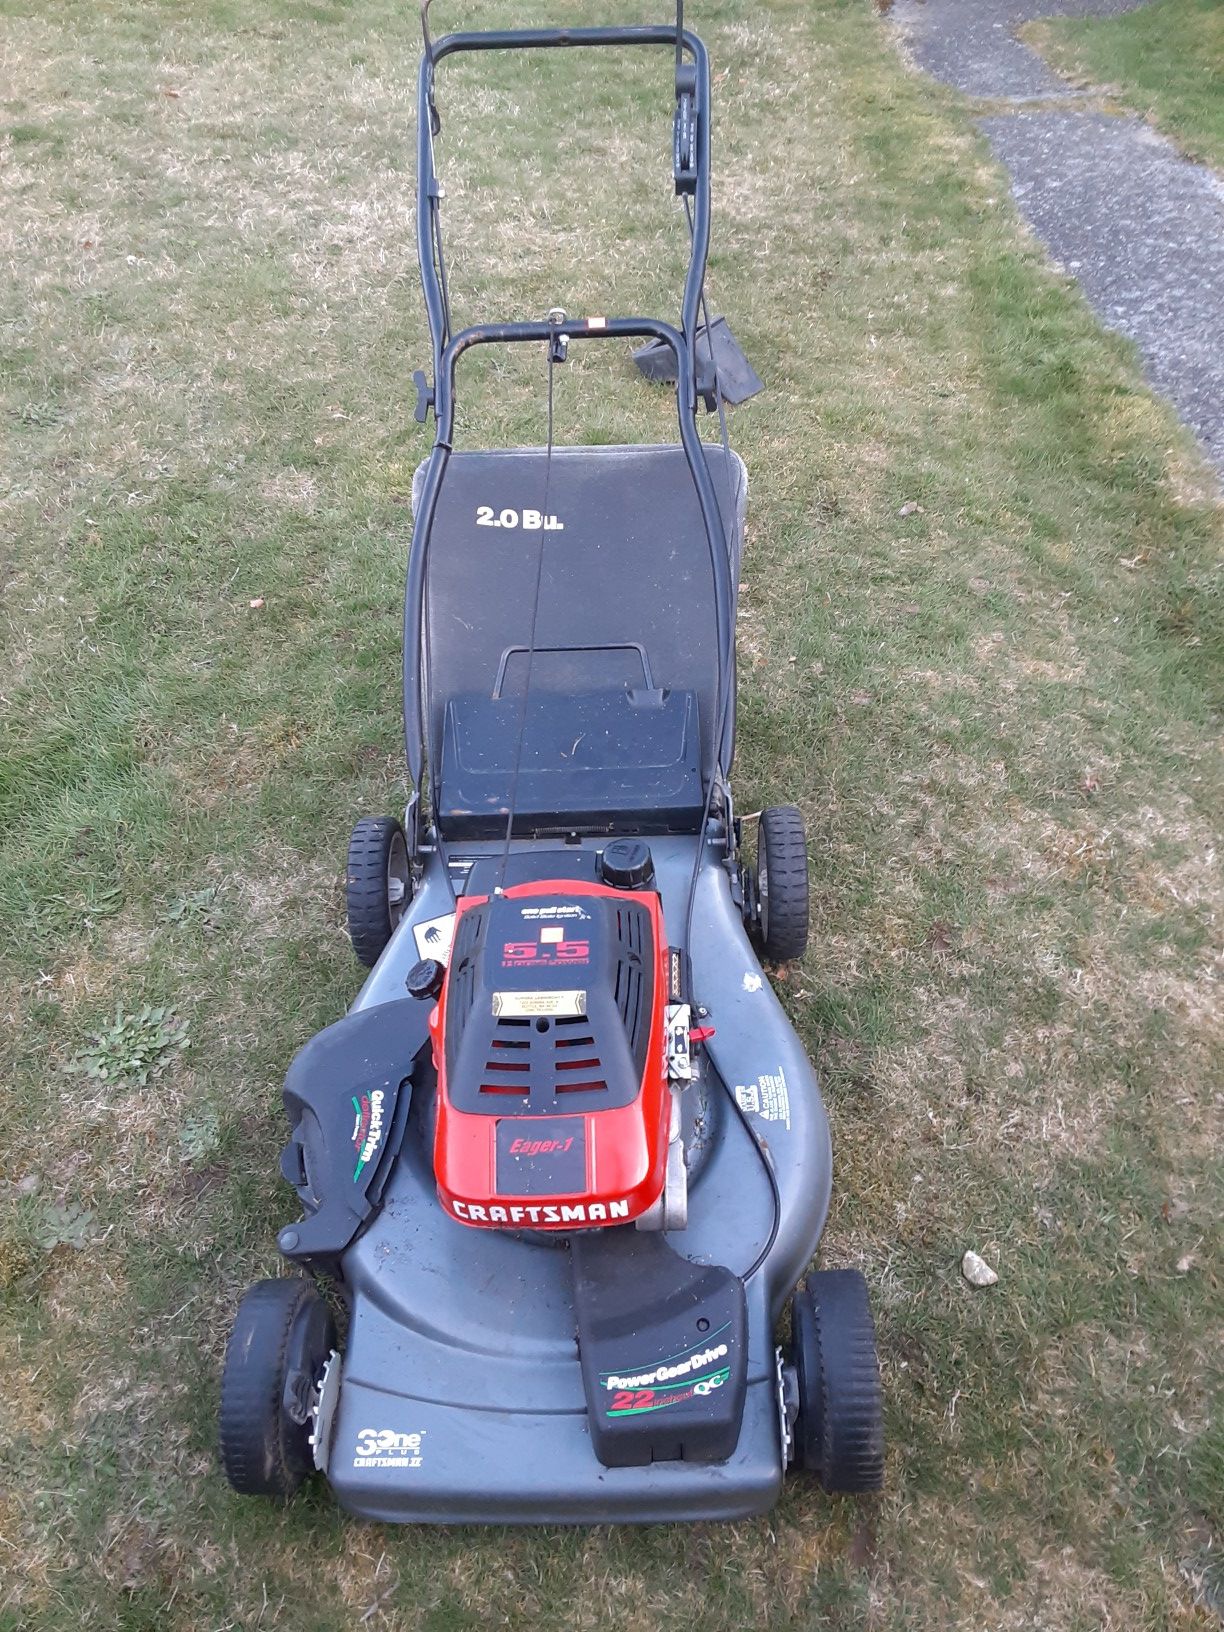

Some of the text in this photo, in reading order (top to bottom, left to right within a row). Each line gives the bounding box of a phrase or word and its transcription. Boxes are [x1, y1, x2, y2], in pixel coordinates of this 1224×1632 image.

[476, 506, 564, 530] 2.0 Bu.
[503, 940, 589, 960] 5.5
[509, 1137, 575, 1156] Eager-1
[452, 1200, 630, 1223] CRAFTSMAN
[611, 1389, 655, 1410] 22
[354, 1457, 409, 1468] CRAFTSMAN
